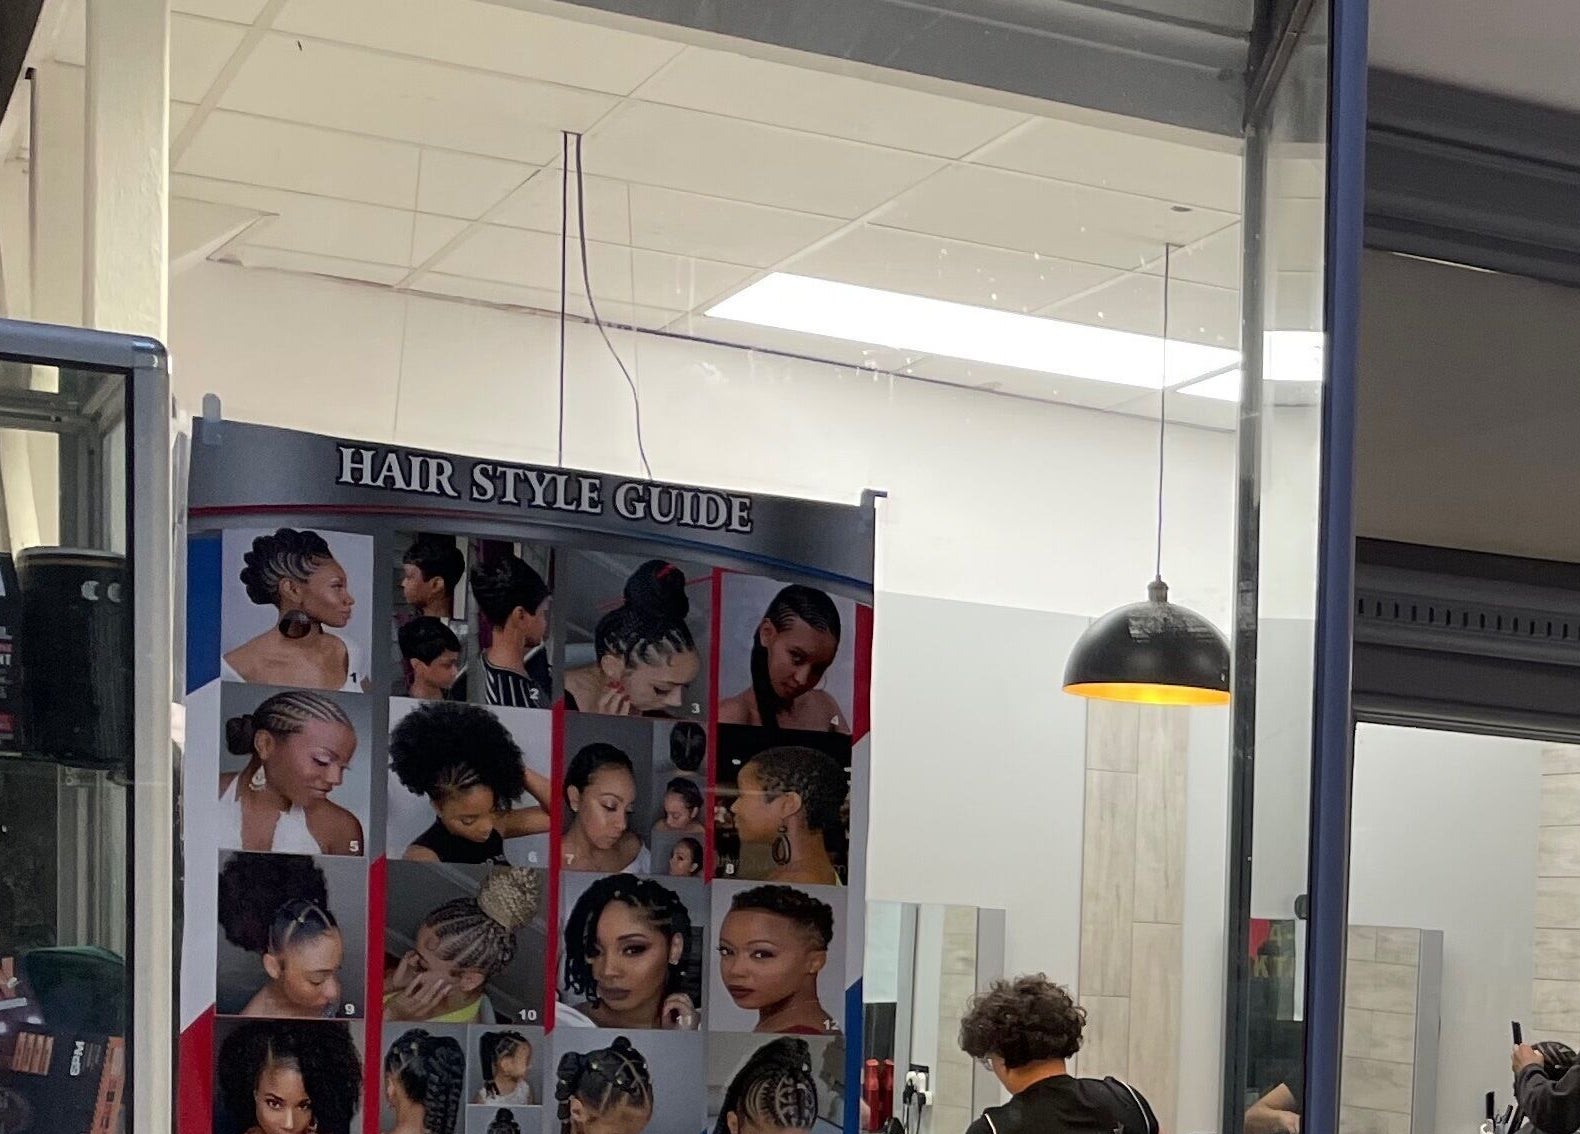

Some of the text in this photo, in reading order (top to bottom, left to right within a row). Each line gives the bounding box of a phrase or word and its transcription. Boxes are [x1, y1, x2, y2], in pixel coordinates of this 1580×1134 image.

[338, 445, 752, 533] HAIR STYLE GUIDE
[349, 672, 357, 683] 1
[529, 688, 539, 700] 2
[691, 703, 700, 713] 3
[830, 715, 839, 726] 4
[349, 840, 359, 852] 5
[528, 851, 538, 863] 6
[565, 853, 574, 865] 7
[725, 863, 734, 874] 8
[344, 1003, 355, 1015] 9
[518, 1009, 537, 1021] 10
[823, 1019, 839, 1030] 12
